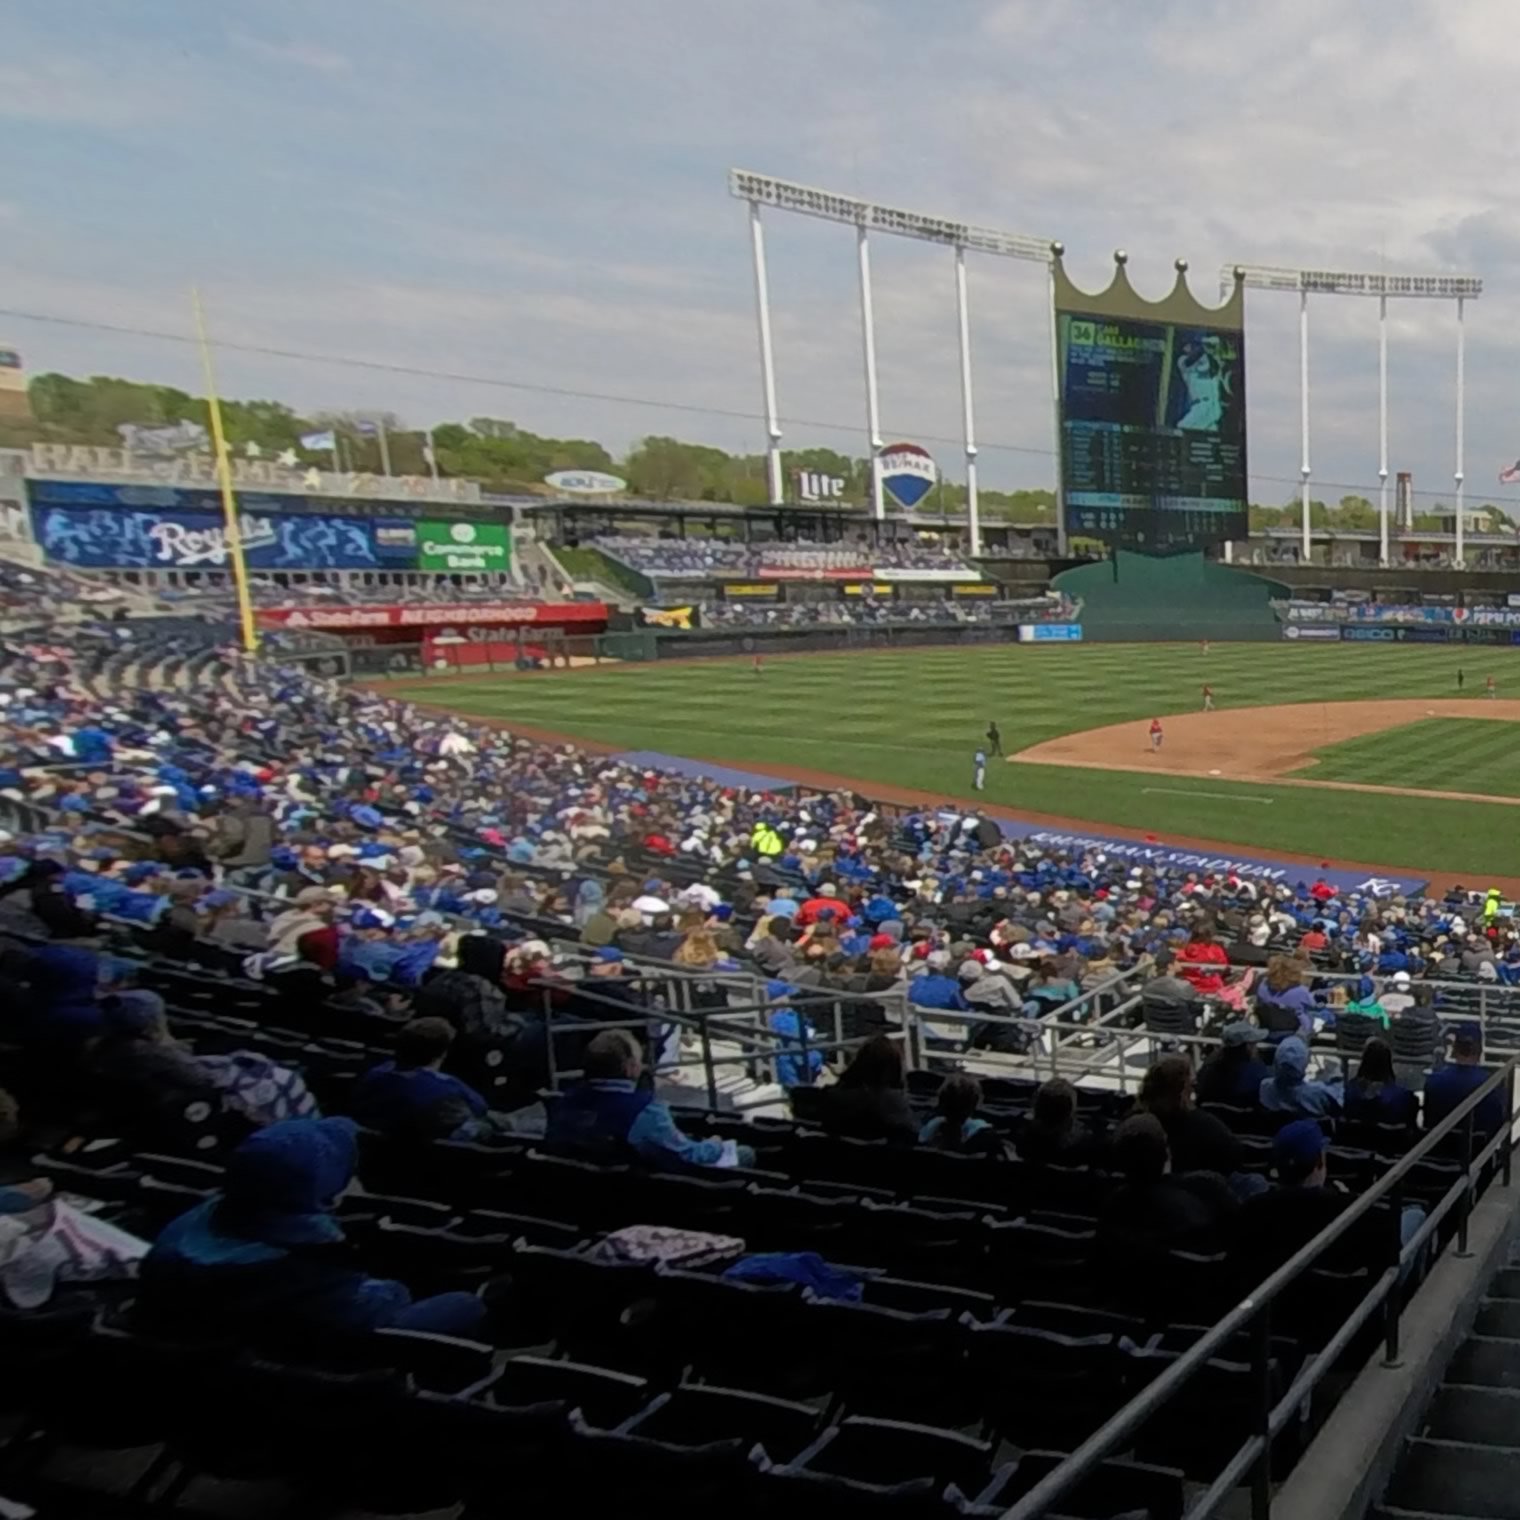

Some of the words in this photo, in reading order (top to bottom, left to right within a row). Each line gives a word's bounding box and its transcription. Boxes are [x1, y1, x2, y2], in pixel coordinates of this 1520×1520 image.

[882, 454, 931, 474] RE/MAX
[801, 472, 845, 501] Lite
[150, 511, 278, 566] Royls
[422, 540, 505, 556] Commerce
[446, 554, 486, 568] Bank
[401, 607, 537, 624] NEIGHBORHOOD
[1473, 611, 1505, 625] PEPSI
[467, 626, 517, 643] State
[519, 624, 565, 641] Farm
[1344, 628, 1394, 641] GEICO
